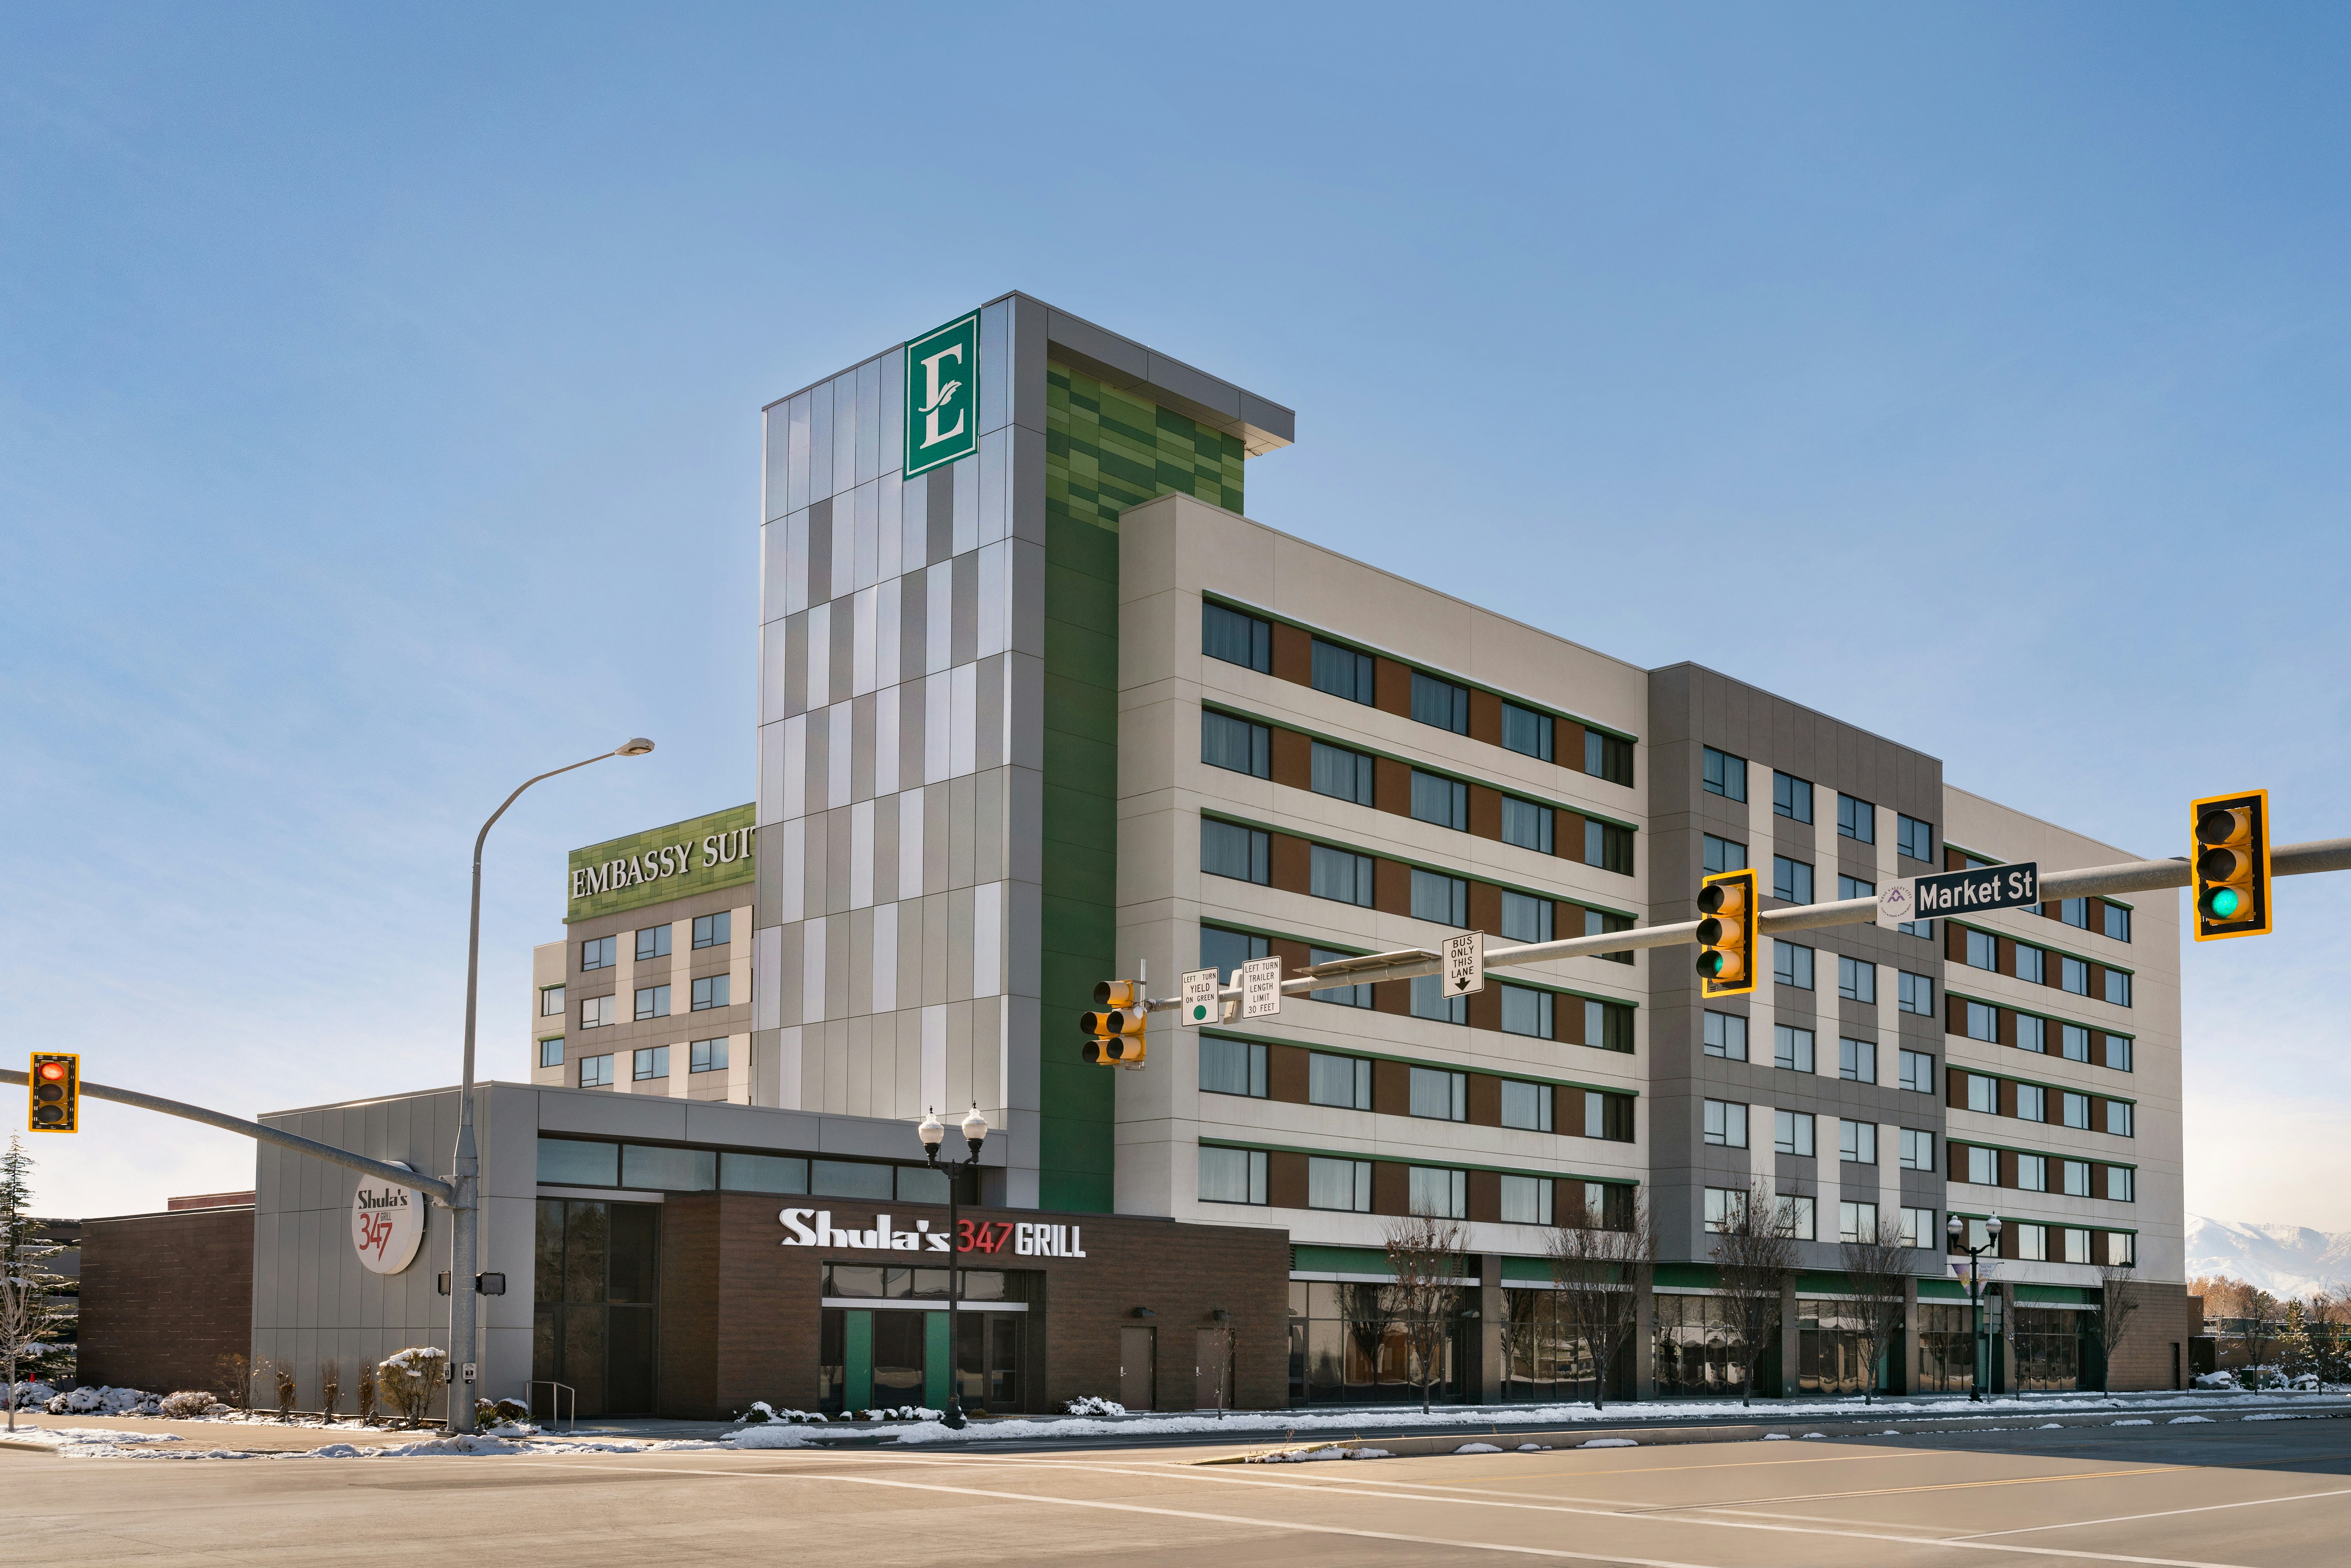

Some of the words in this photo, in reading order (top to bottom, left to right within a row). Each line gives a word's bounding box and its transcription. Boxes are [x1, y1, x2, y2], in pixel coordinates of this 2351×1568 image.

[918, 343, 964, 450] E
[571, 842, 694, 899] EMBASSY
[1920, 873, 2001, 911] Market
[2008, 870, 2033, 899] St
[1453, 936, 1472, 948] BUS
[1451, 946, 1474, 958] ONLY
[1245, 964, 1259, 973] LEFT
[1262, 961, 1278, 970] TURN
[1453, 956, 1472, 967] THIS
[1249, 972, 1274, 983] TRAILER
[1452, 966, 1474, 978] LANE
[1190, 983, 1210, 993] YIELD
[1250, 982, 1273, 993] LENGTH
[1197, 994, 1214, 1002] GREEN
[1253, 993, 1270, 1003] LIMIT
[1248, 1005, 1256, 1014] 30
[1260, 1003, 1275, 1012] FEET
[358, 1188, 407, 1209] Shula's
[381, 1211, 392, 1221] GRILL
[359, 1212, 392, 1262] 347
[779, 1208, 950, 1252] Shula's
[957, 1219, 1014, 1254] 347
[1015, 1223, 1086, 1258] GRILL
